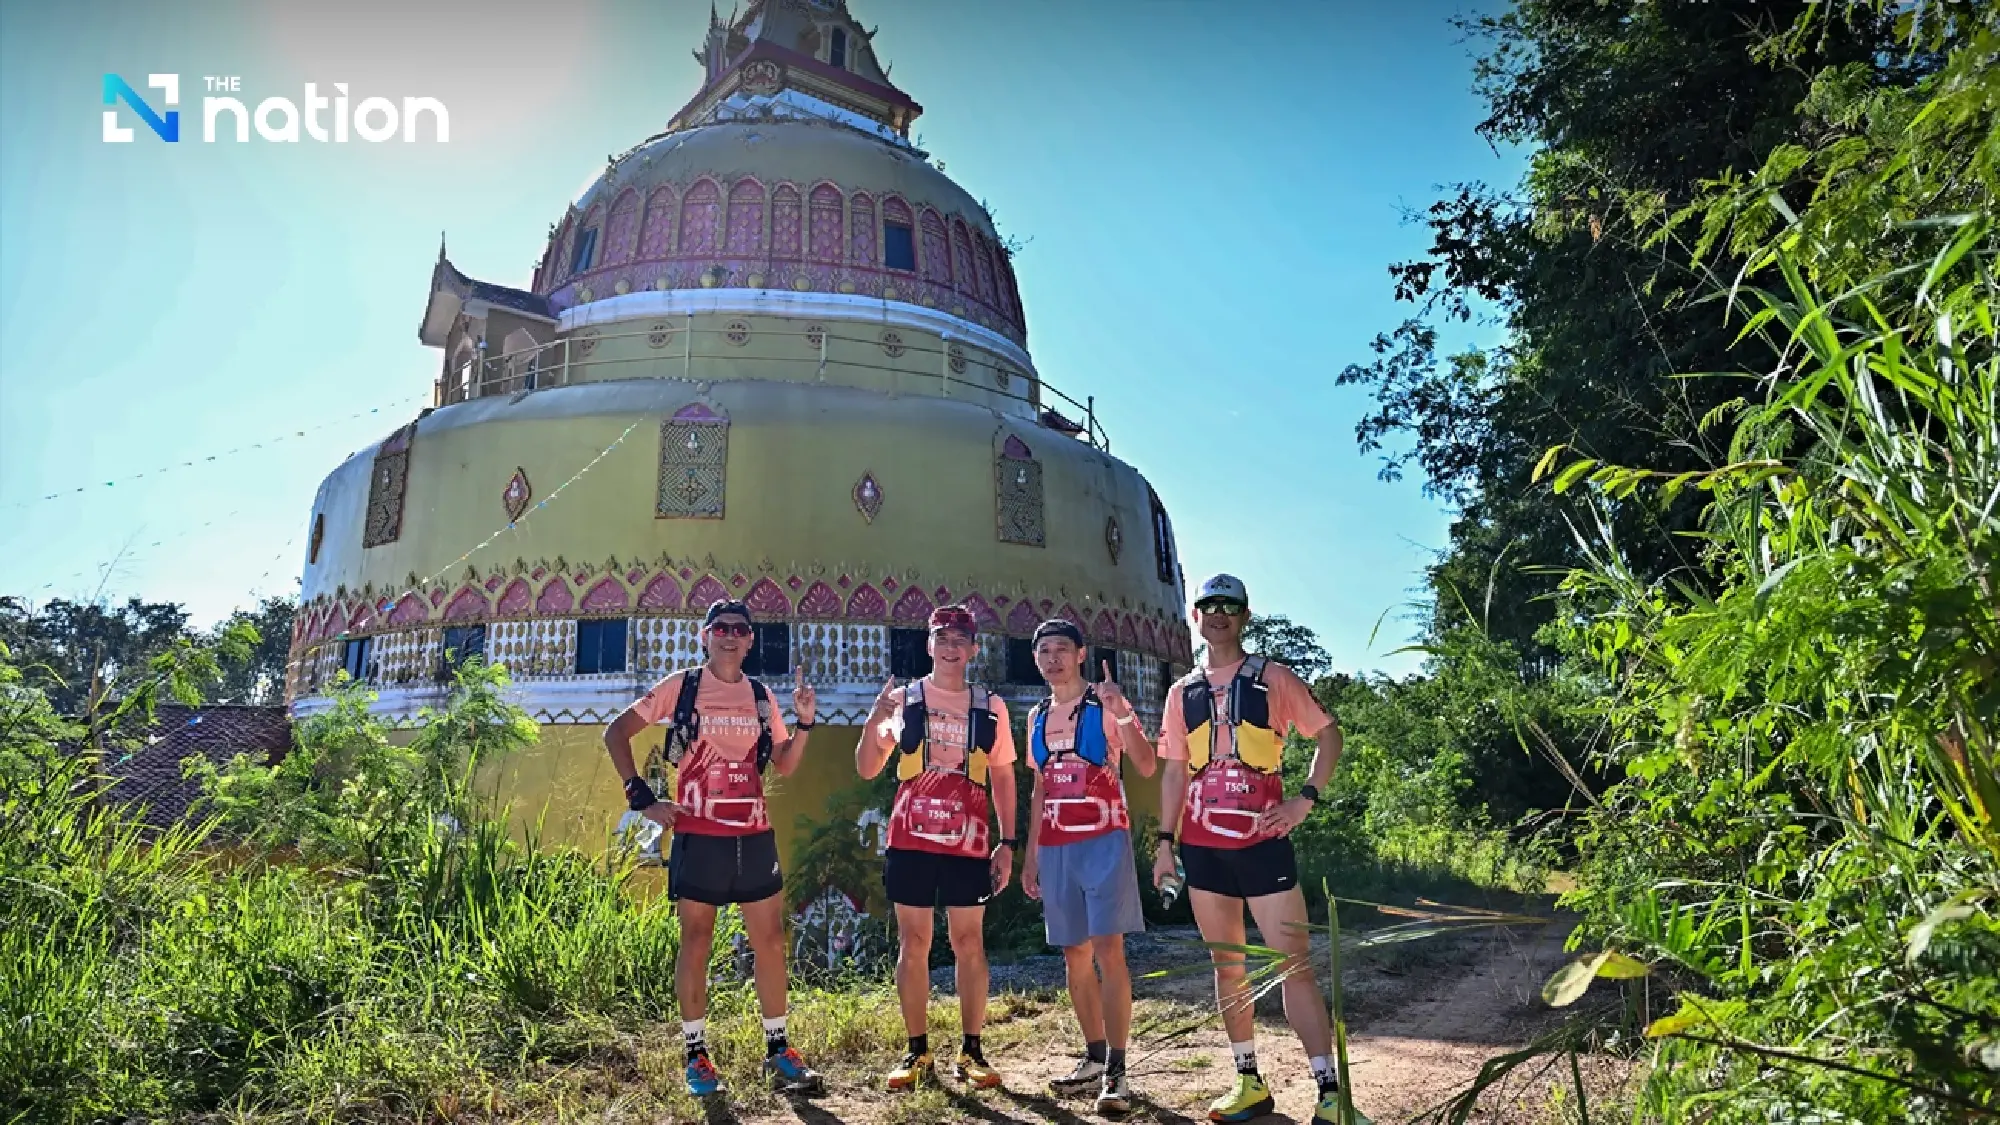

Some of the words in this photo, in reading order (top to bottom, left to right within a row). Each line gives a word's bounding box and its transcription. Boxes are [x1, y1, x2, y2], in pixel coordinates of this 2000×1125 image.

[728, 773, 750, 783] T504
[1053, 773, 1073, 783] T504
[928, 809, 951, 820] T504
